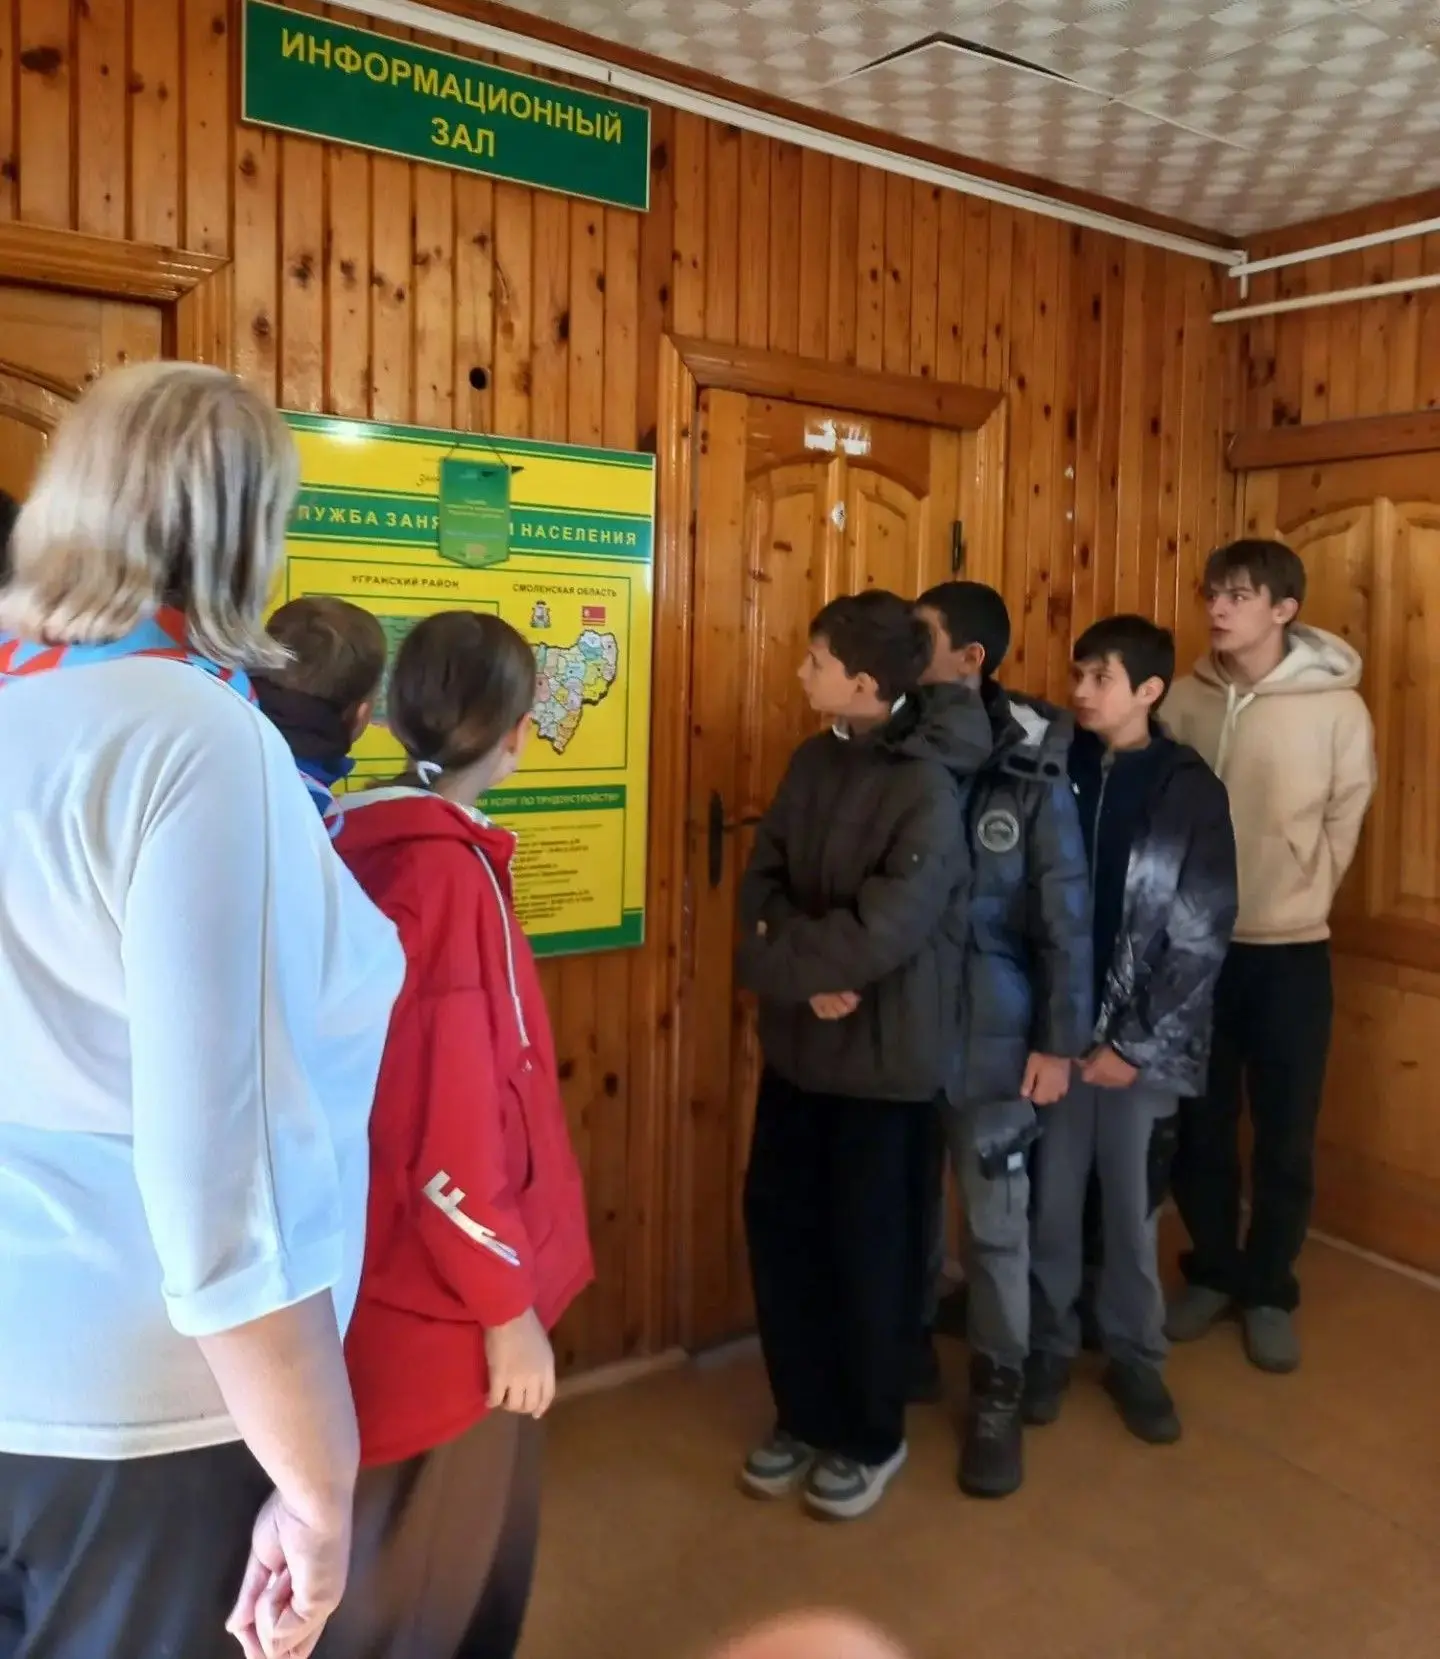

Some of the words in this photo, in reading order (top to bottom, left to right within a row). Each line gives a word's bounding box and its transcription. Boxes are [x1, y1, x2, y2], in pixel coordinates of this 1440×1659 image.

[281, 28, 622, 144] ИНФОРМАЦИОННЫЙ
[431, 117, 495, 157] ЗАЛ
[298, 505, 379, 526] ЛУЖБА
[521, 523, 637, 546] НАСЕЛЕНИЯ
[351, 575, 419, 587] УГРАНСКИЙ
[421, 578, 459, 588] РАЙОН
[512, 583, 575, 594] СМОЛЕНСКАЯ
[576, 587, 618, 597] ОБЛАСТЬ
